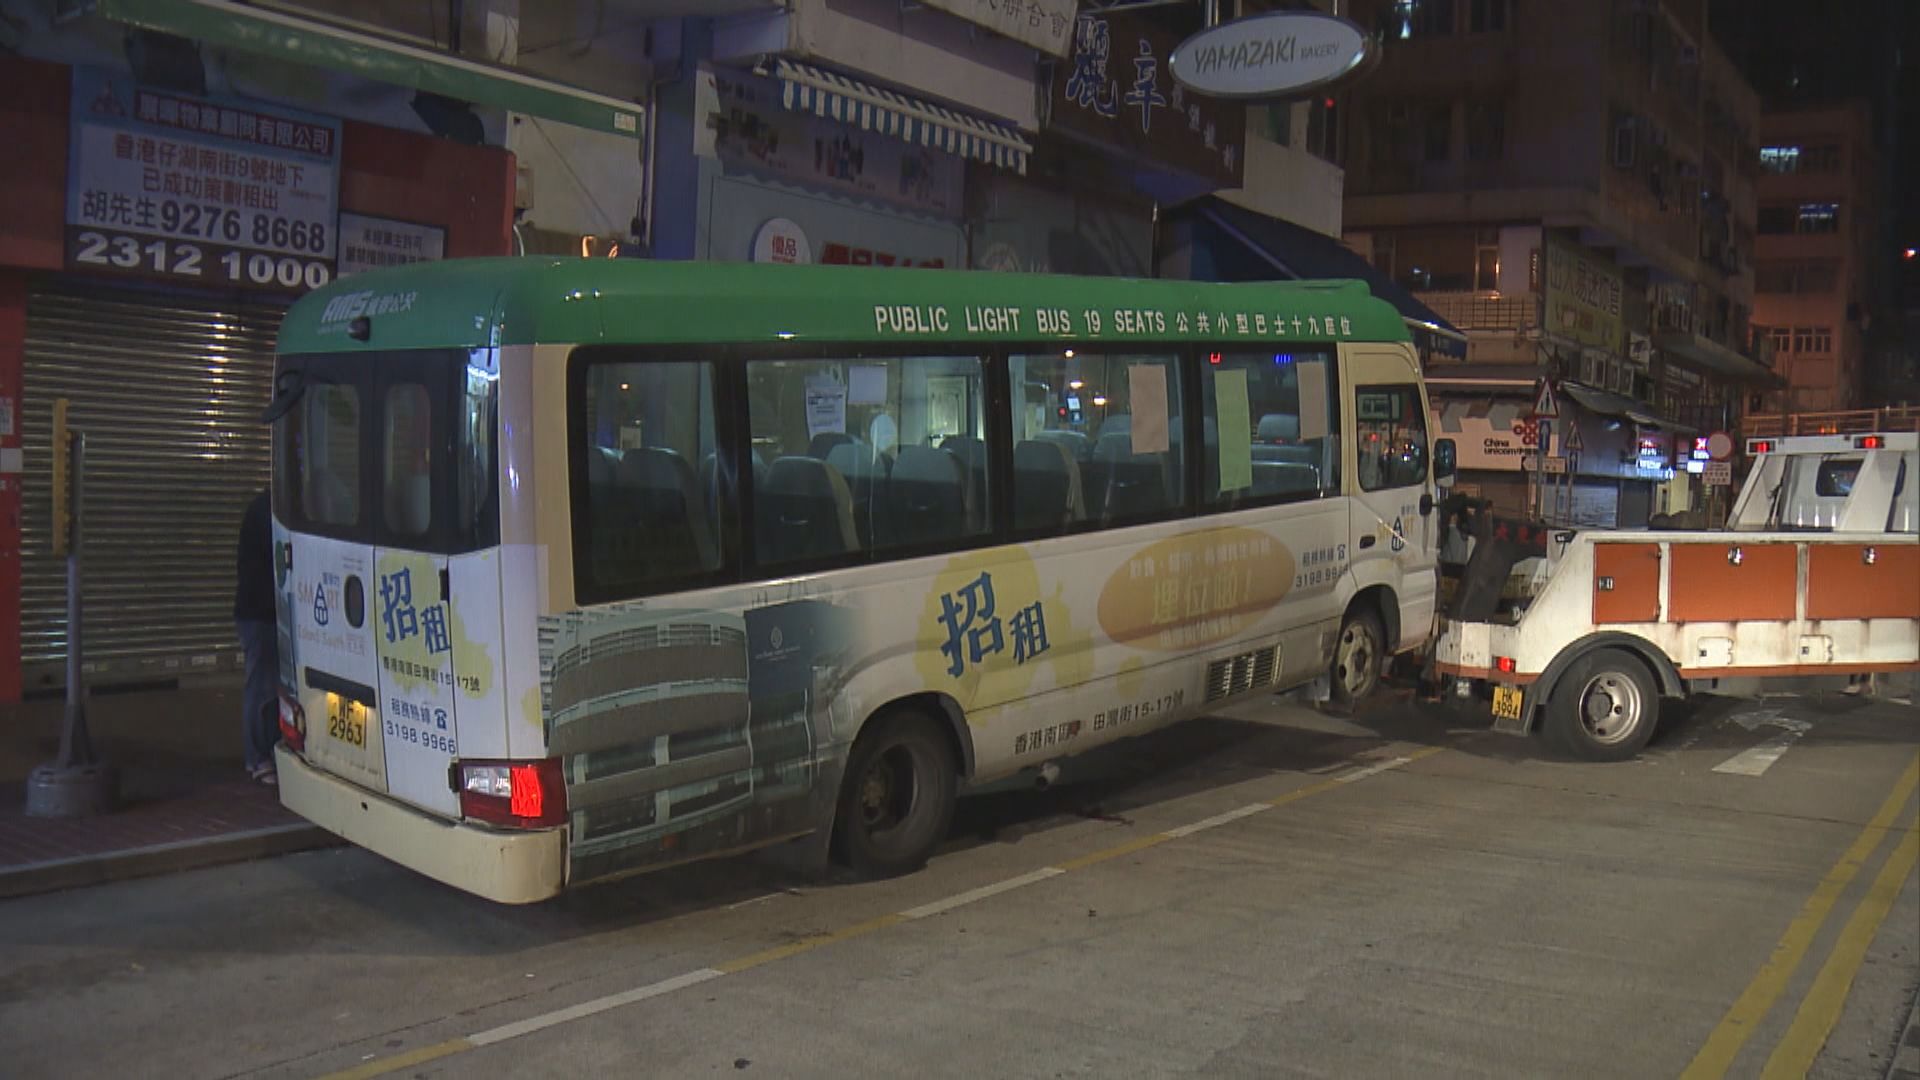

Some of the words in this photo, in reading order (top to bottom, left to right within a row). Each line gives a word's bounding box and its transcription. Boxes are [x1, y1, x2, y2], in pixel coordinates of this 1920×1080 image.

[1194, 37, 1296, 73] YAMAZAKI
[1301, 42, 1340, 60] BAKERY
[159, 200, 240, 242] 9276
[251, 214, 325, 253] 8668
[76, 232, 202, 276] 2312
[221, 251, 329, 290] 1000
[875, 305, 949, 333] PUBLIC
[964, 306, 1020, 333] LIGHT
[1036, 307, 1070, 332] BUS
[1083, 309, 1101, 332] 19
[1114, 310, 1165, 333] SEATS
[1176, 312, 1351, 336] 公共小型巴士十九座位
[1483, 438, 1510, 447] China
[377, 567, 450, 656] 招租
[937, 570, 1050, 679] 招租
[330, 715, 362, 746] 2963
[386, 720, 418, 744] 3198
[421, 731, 457, 755] 9966
